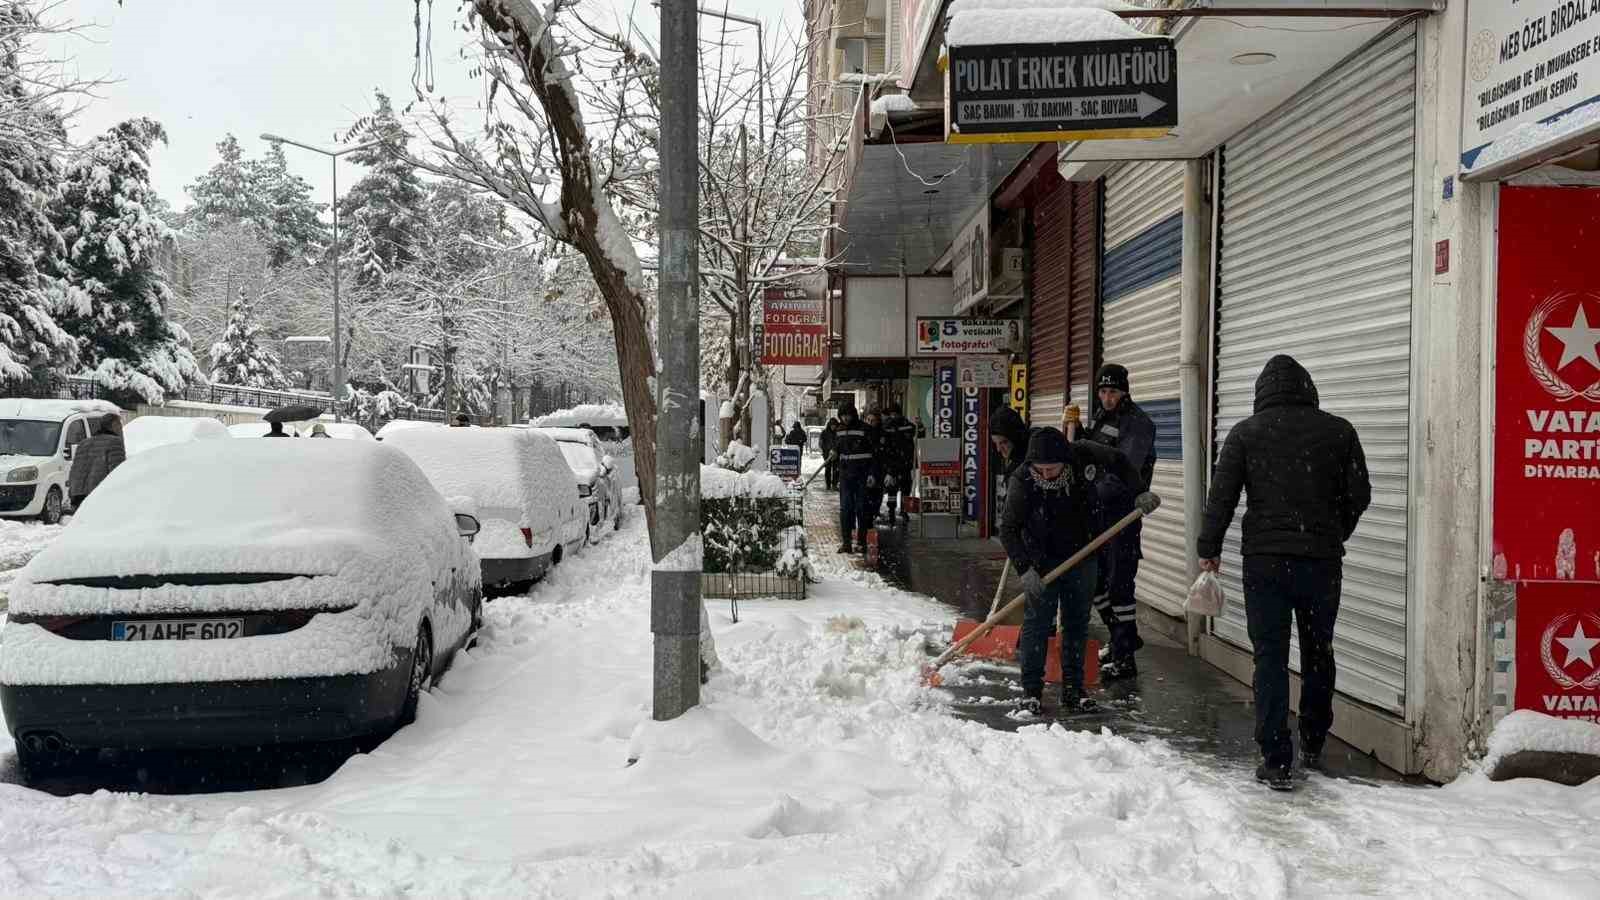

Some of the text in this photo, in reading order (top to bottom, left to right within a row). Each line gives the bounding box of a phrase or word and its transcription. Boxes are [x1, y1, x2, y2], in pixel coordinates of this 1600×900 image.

[1499, 31, 1520, 64] MEB
[1522, 16, 1548, 51] ÖZEL
[1547, 40, 1592, 76] MUHASEBE
[955, 46, 1170, 92] POLAT ERKEK KUAFÖRÜ
[1522, 86, 1549, 113] TEKNİK
[1549, 71, 1578, 100] SERVİS
[963, 104, 982, 123] SAÇ
[983, 103, 1015, 120] BAKIMI
[1023, 101, 1040, 118] YÜZ
[1041, 101, 1073, 118] BAKIMI
[1080, 100, 1099, 119] SAÇ
[1100, 98, 1138, 115] BOYAMA
[942, 320, 958, 336] 5
[201, 621, 239, 639] 602
